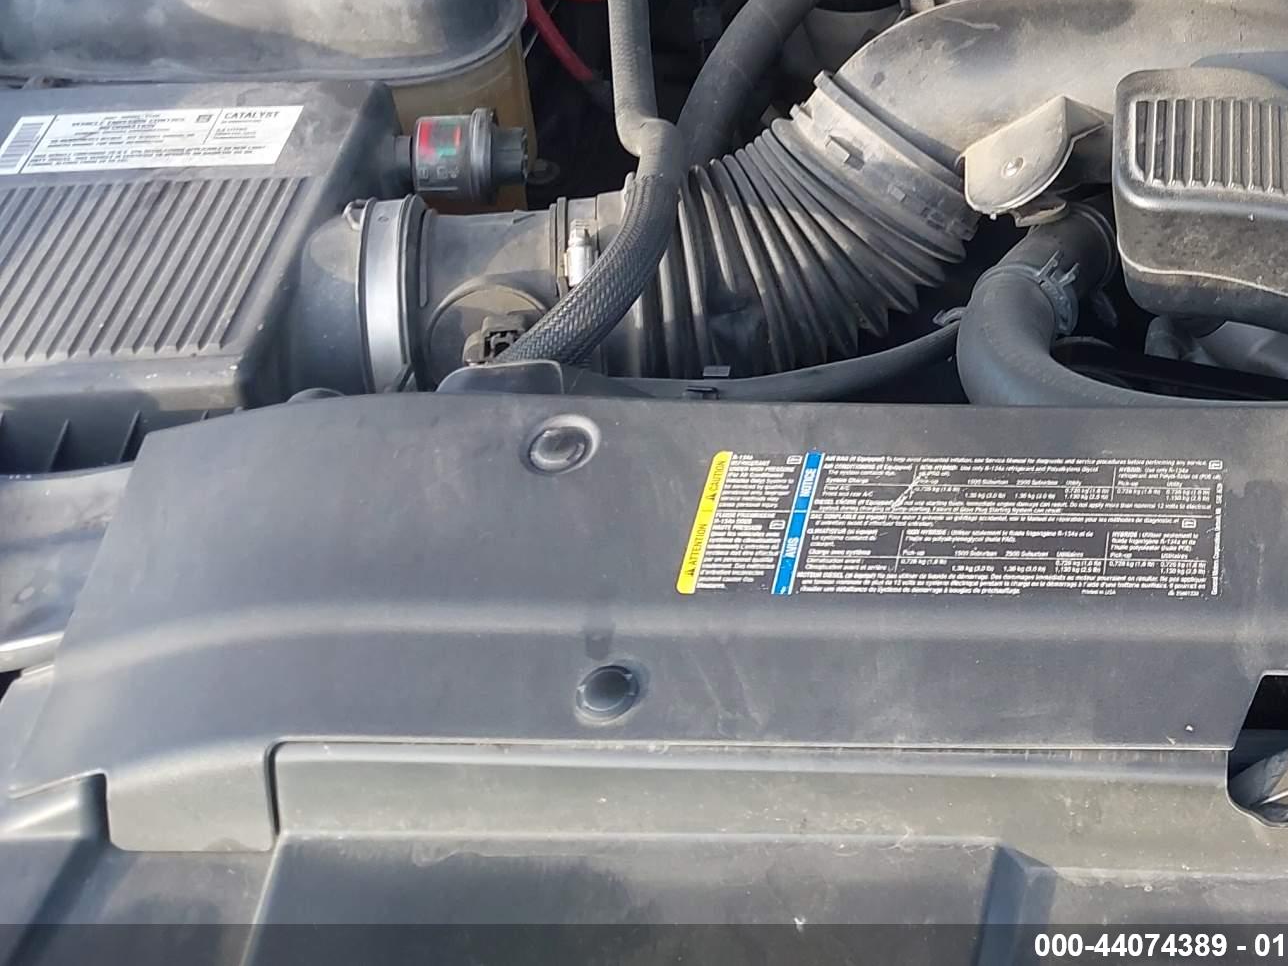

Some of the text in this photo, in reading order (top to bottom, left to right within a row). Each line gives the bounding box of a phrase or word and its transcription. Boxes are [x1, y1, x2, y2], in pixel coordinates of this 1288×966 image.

[708, 460, 726, 491] CAUTION
[799, 468, 816, 497] NOTICE
[688, 523, 709, 568] ATTENTION
[783, 536, 800, 558] AVIS
